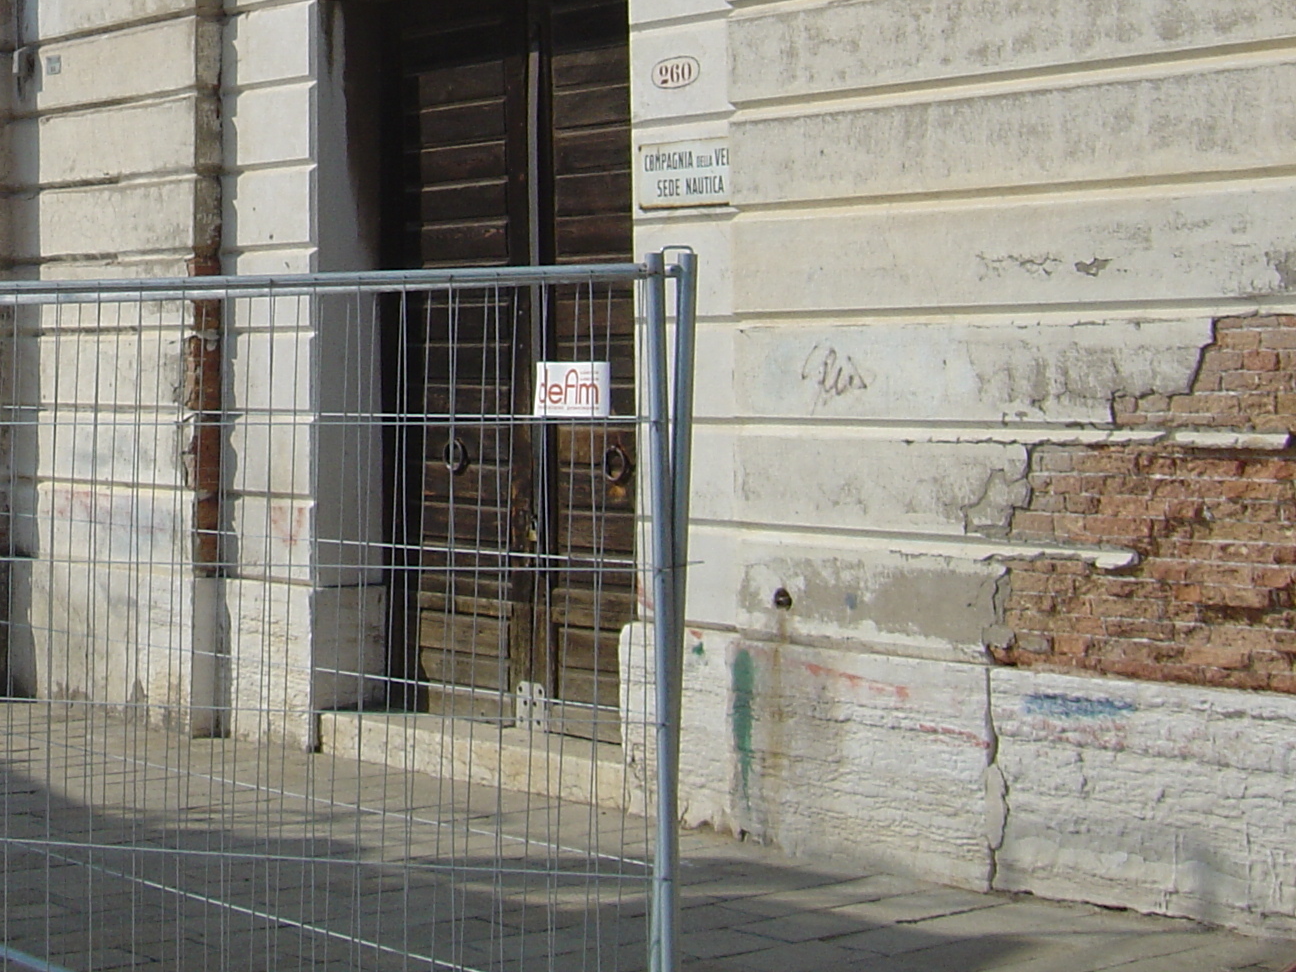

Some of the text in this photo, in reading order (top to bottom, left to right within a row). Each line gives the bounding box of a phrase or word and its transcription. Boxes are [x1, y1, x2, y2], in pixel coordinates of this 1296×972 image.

[659, 62, 692, 85] 260
[644, 150, 693, 172] COMPAGNIA
[696, 155, 712, 168] DELLA
[657, 175, 724, 197] SEDE NAUTICA
